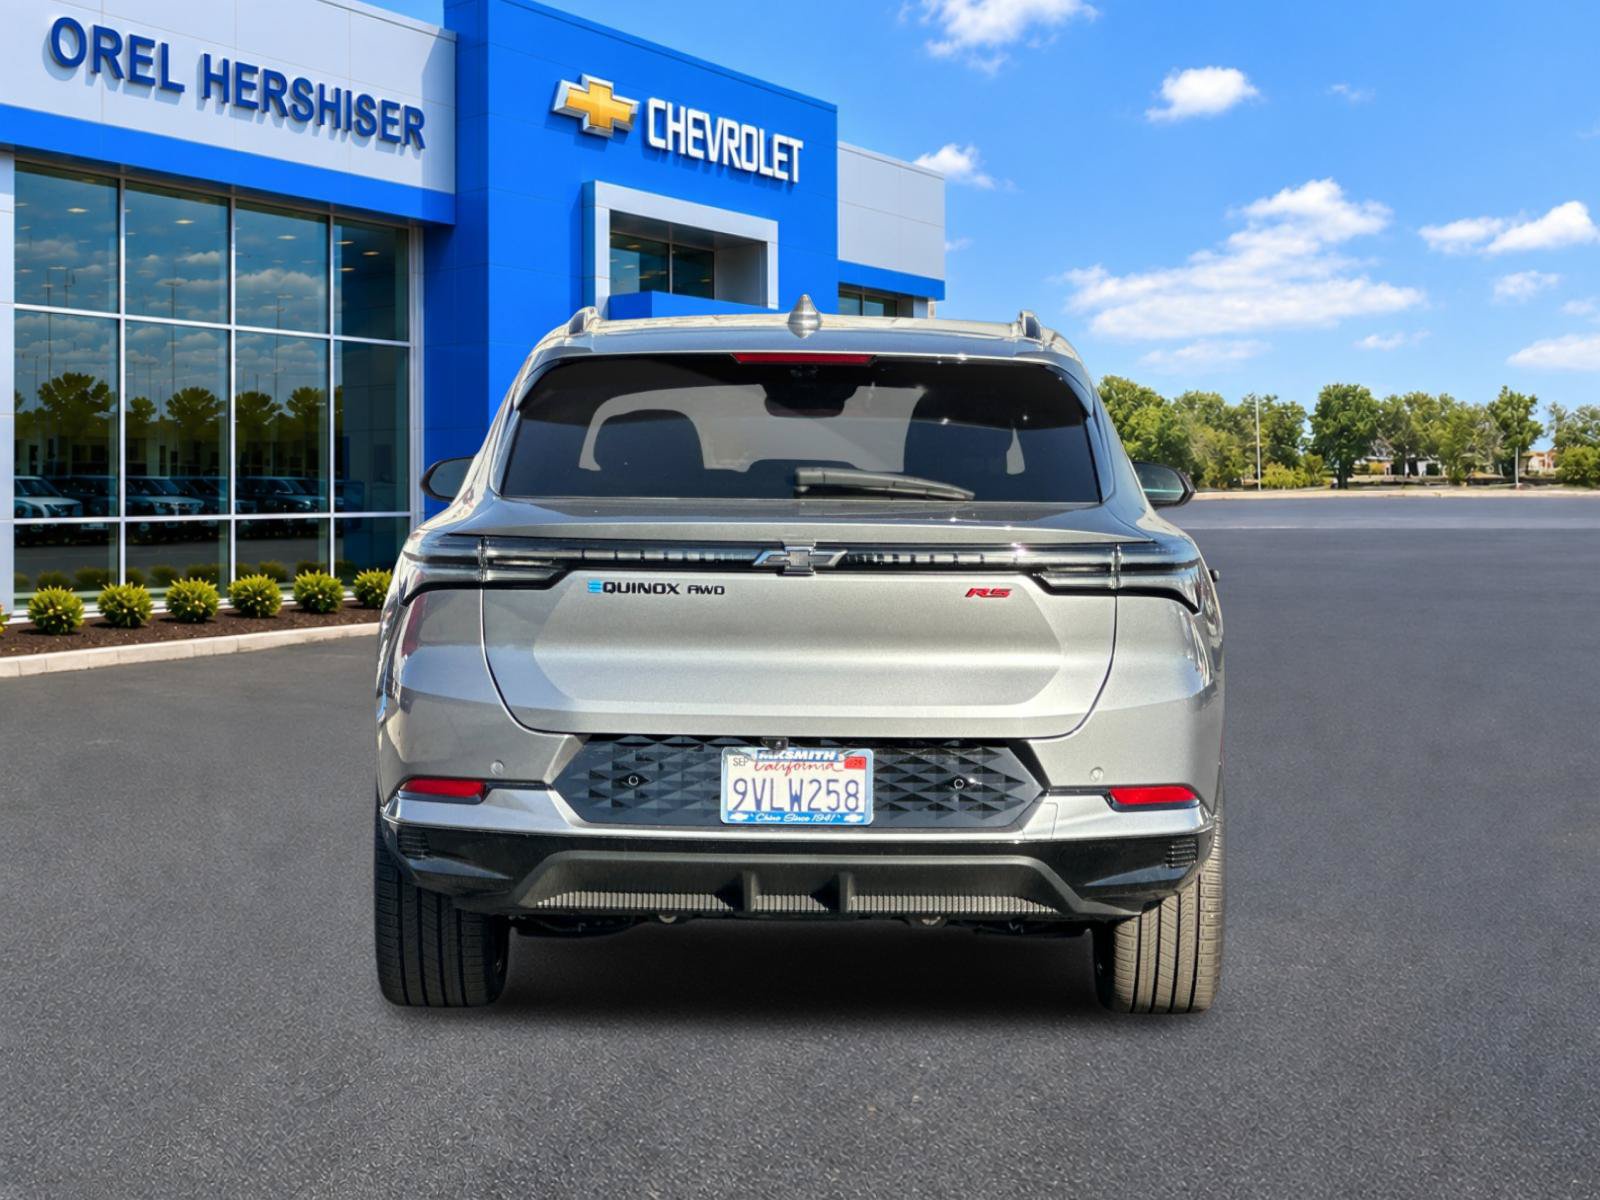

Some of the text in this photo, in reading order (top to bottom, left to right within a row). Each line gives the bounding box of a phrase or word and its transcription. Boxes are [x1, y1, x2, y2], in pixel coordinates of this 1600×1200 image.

[50, 17, 425, 150] OREL HERSHISER
[648, 97, 803, 183] CHEVROLET
[587, 580, 725, 595] EQUINOX AWD
[965, 588, 1011, 598] RS
[733, 757, 748, 767] SEP
[754, 760, 844, 776] California
[733, 778, 859, 812] 9VLW258
